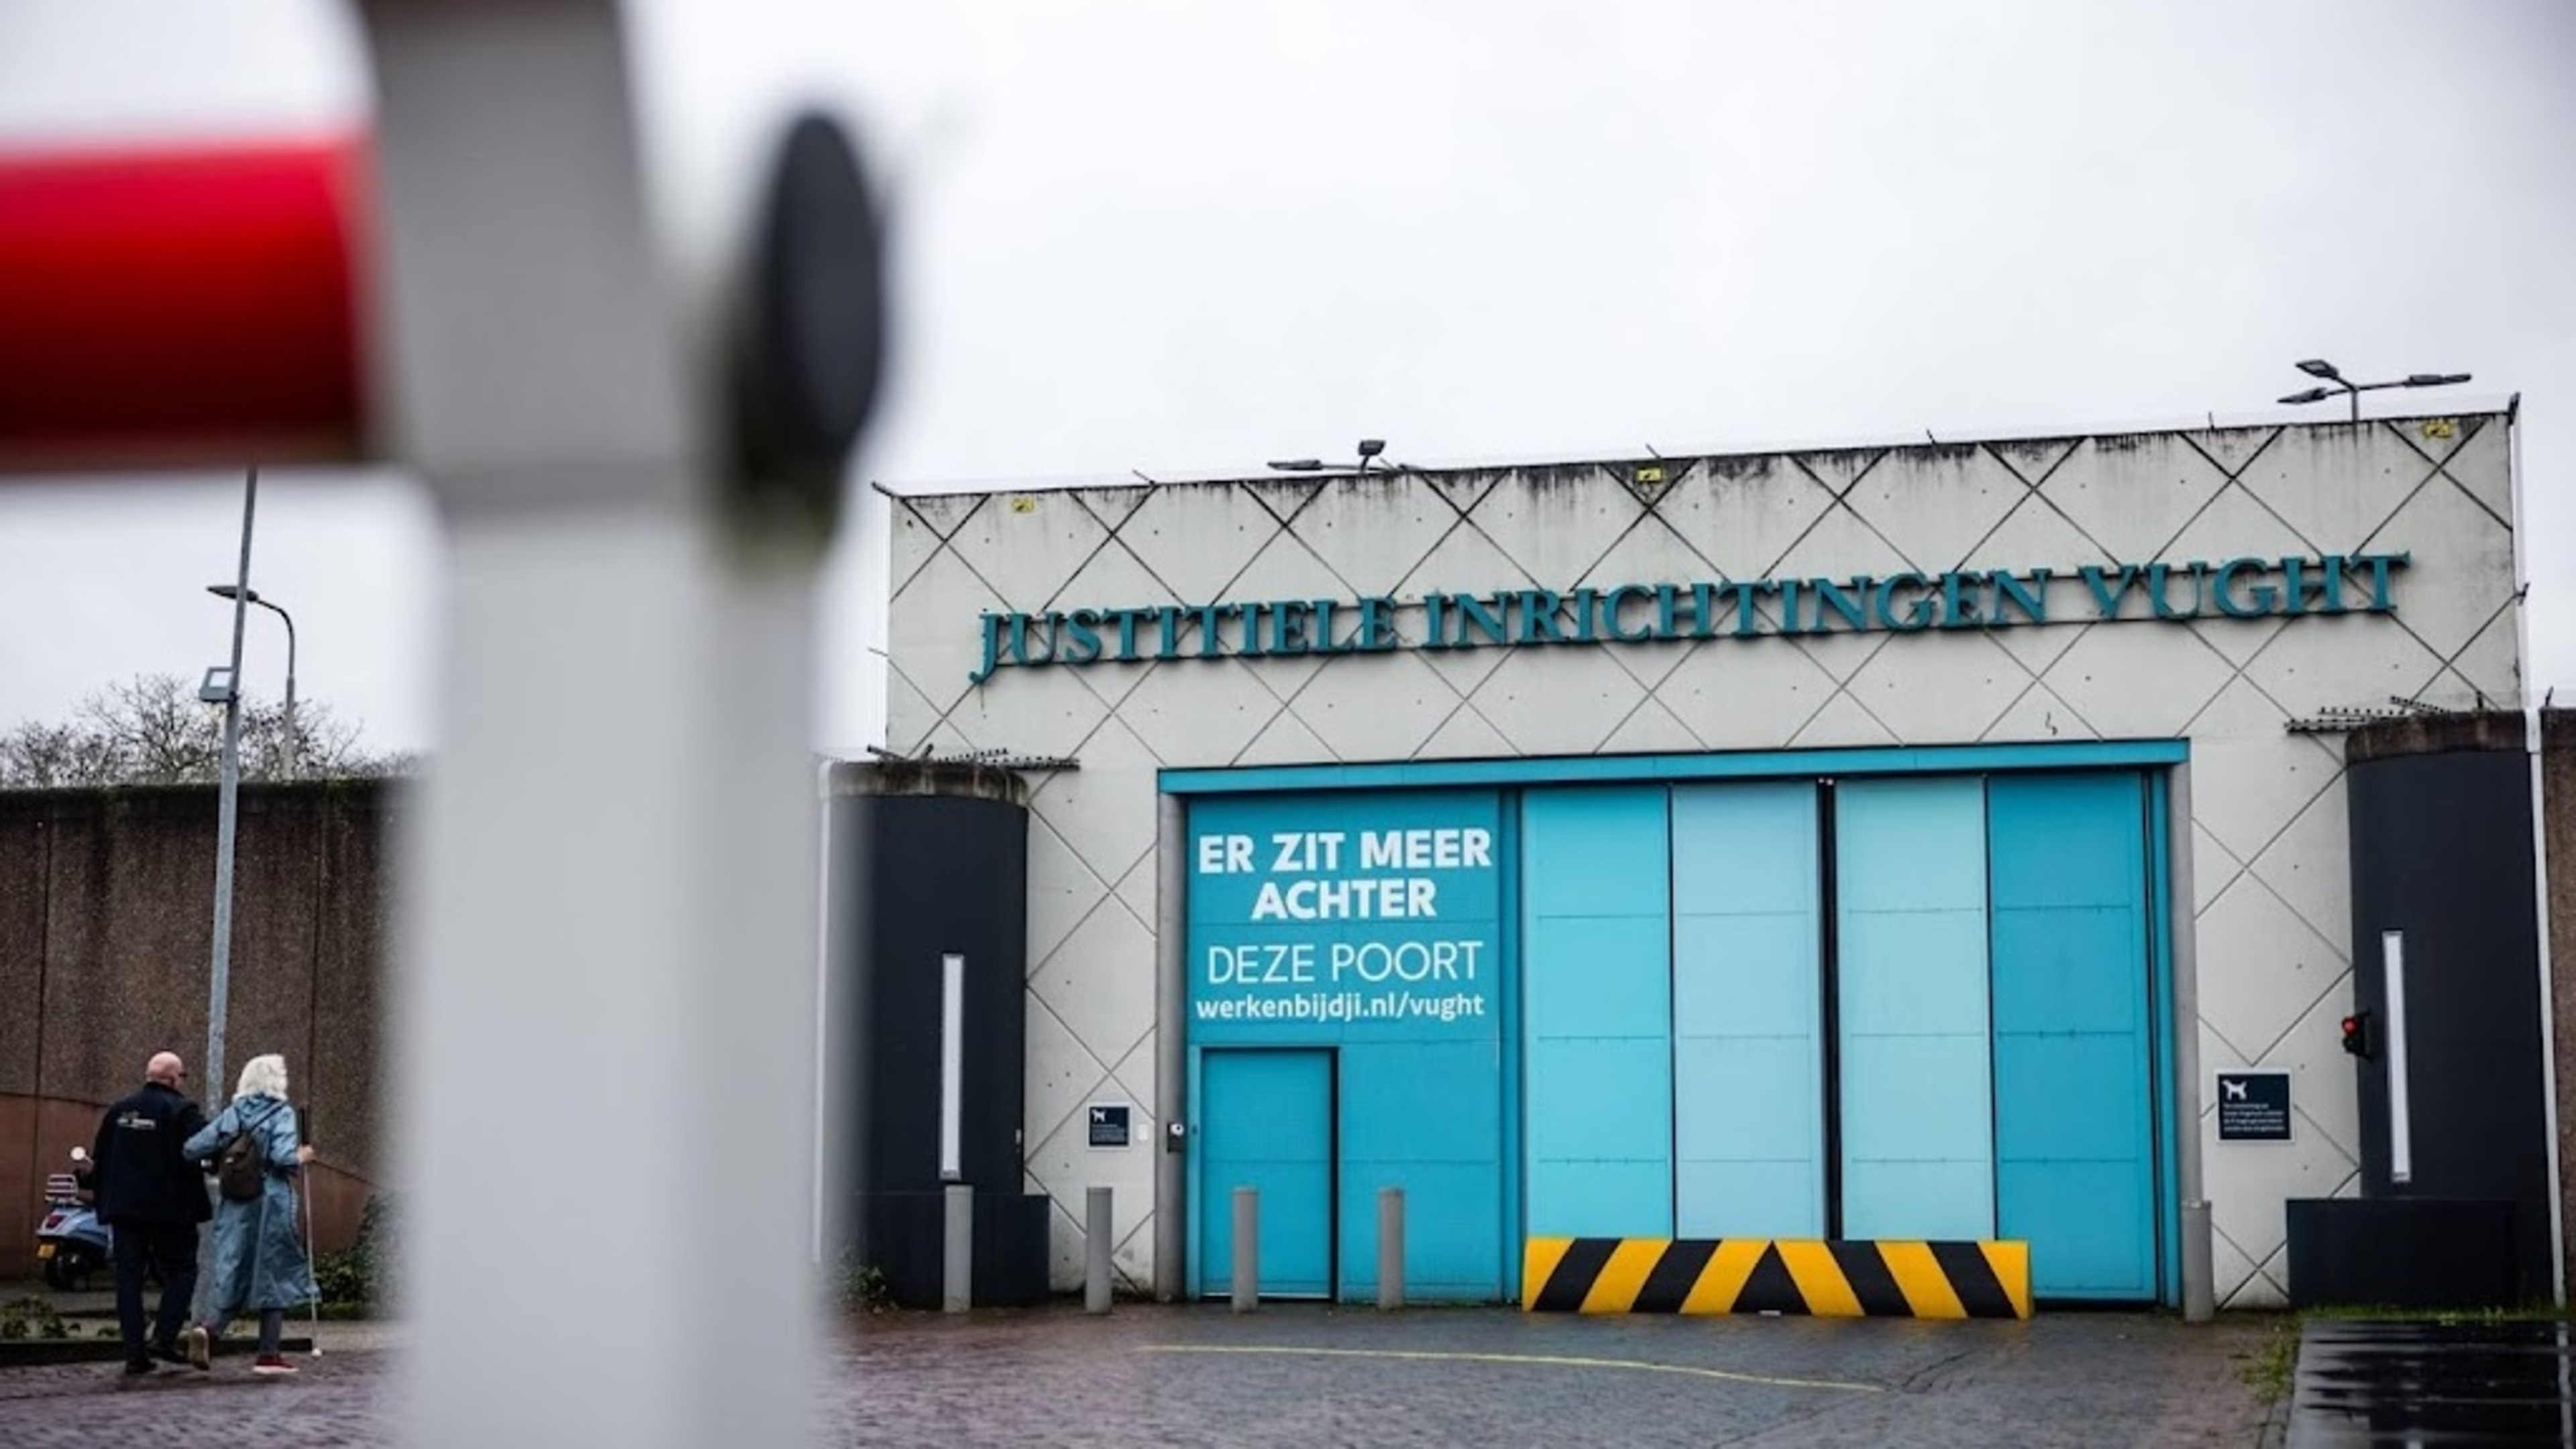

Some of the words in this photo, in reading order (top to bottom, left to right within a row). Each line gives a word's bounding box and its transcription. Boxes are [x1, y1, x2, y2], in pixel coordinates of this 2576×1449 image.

[969, 596, 1397, 683] JUSTITIELE
[1421, 568, 2051, 648] INRICHTINGEN
[2078, 550, 2410, 621] VUGHT
[1199, 835, 1254, 873] ER
[1271, 832, 1345, 871] ZIT
[1360, 828, 1492, 869] MEER
[1250, 877, 1437, 920] ACHTER
[1209, 944, 1316, 984] DEZE
[1332, 941, 1483, 981] POORT
[1196, 991, 1484, 1022] werkenbijdji.nl/vught
